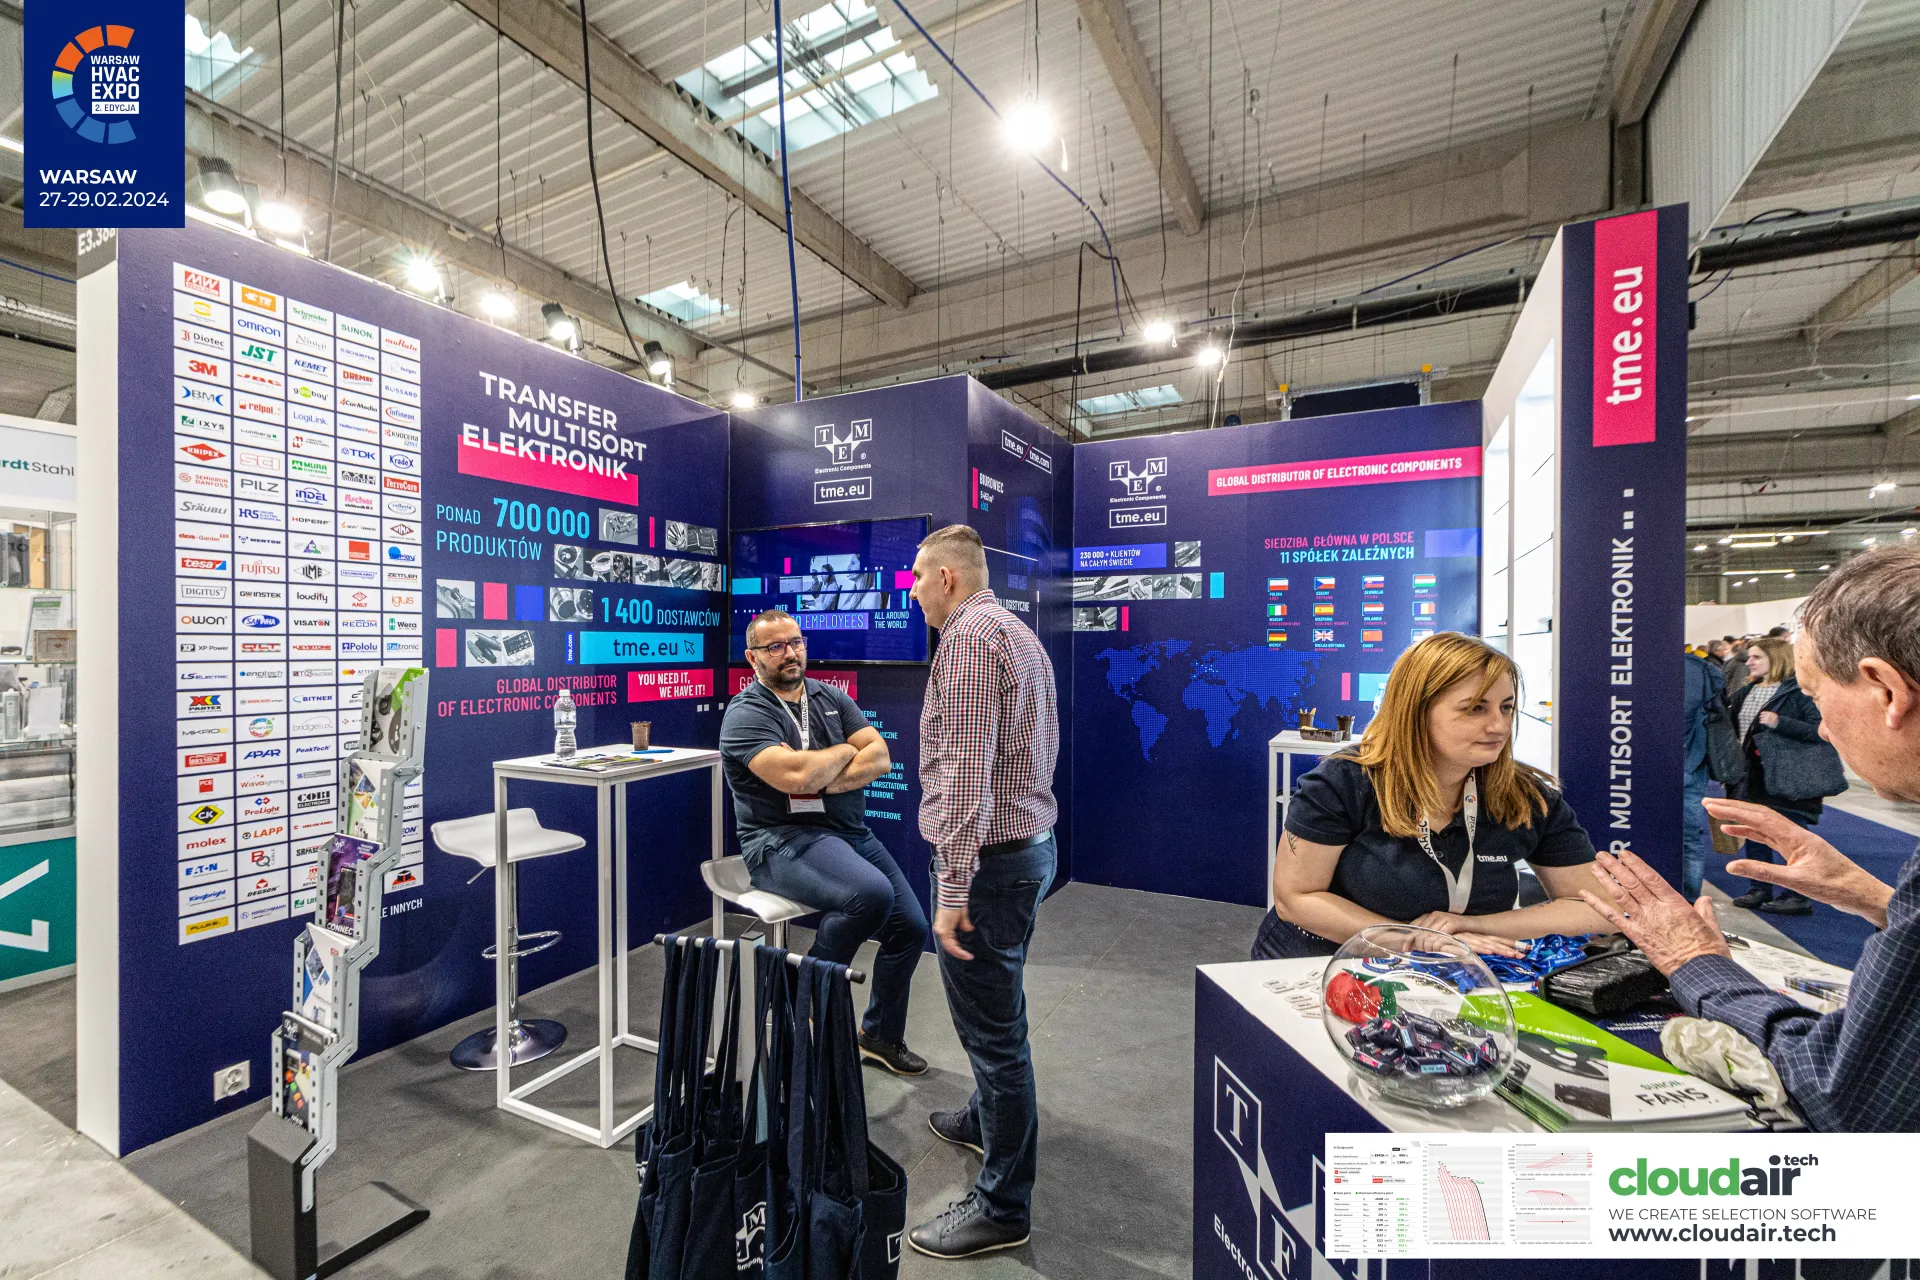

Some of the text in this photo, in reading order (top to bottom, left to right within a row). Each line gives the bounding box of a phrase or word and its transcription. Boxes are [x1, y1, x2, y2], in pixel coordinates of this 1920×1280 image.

[293, 307, 327, 322] Schneider
[341, 324, 373, 338] SUNON
[1605, 266, 1643, 406] tme.eu
[193, 332, 224, 347] Diotec
[241, 344, 277, 362] JST
[188, 360, 218, 376] 3M
[294, 359, 328, 372] KEMET
[479, 371, 618, 431] TRANSFER
[199, 420, 224, 430] IXYS
[293, 412, 327, 425] LogiLink
[508, 407, 647, 461] MULTISORT
[187, 447, 219, 458] KNIPEX
[349, 448, 376, 460] TDK
[462, 422, 628, 480] ELEKTRONIK
[1004, 436, 1050, 469] tme.eu tme.com
[0, 458, 76, 477] rdtStahl
[304, 461, 328, 470] MURR
[815, 463, 872, 474] Electronic Components
[196, 474, 228, 483] SEMIKRON
[1216, 457, 1462, 488] GLOBAL DISTRIBUTOR OF ELECTRONIC COMPONENTS
[196, 480, 228, 488] DANFOSS
[240, 478, 280, 493] PILZ
[386, 478, 418, 492] FerroCore
[980, 472, 1004, 494] BIUROWIEC
[820, 484, 865, 498] tme.eu
[238, 508, 259, 519] HRS
[436, 497, 590, 539] PONAD 700 000
[1116, 511, 1160, 524] tme.eu
[436, 530, 542, 560] PRODUKTÓW
[1264, 531, 1414, 550] SIEDZIBA GŁÓWNA W POLSCE
[1080, 548, 1141, 560] 230 000 KLIENTÓW
[1280, 546, 1415, 564] 11 SPÓŁEK ZALEŻNYCH
[184, 558, 214, 568] tesa
[241, 561, 280, 576] FUJITSU
[1080, 556, 1133, 568] NA CAŁYM ŚWIECIE
[186, 588, 220, 596] DIGITUS
[296, 592, 328, 604] loudity
[392, 596, 414, 607] igus
[774, 604, 788, 612] OVER
[615, 598, 653, 625] 400
[656, 608, 720, 627] DOSTAWCÓW
[874, 611, 910, 620] ALL AROUND
[398, 622, 418, 630] Wera
[805, 614, 864, 628] EMPLOYEES
[874, 620, 908, 629] THE WORLD
[351, 642, 378, 650] Pololu
[614, 638, 678, 656] tme.eu
[496, 674, 617, 694] GLOBAL DISTRIBUTOR
[638, 672, 691, 686] YOU NEED IT,
[1610, 537, 1634, 829] MULTISORT ELEKTRONIK
[660, 685, 706, 698] WE HAVE IT!
[438, 701, 454, 717] OF
[460, 695, 541, 716] ELECTRONIC
[244, 749, 281, 760] APAR
[296, 746, 330, 754] PeakTech
[871, 782, 908, 791] WARSZTATOWE
[298, 790, 330, 802] COBI
[871, 790, 894, 800] BIUROWE
[298, 800, 330, 808] ELECTRONIC
[244, 806, 280, 816] ProLight
[253, 826, 283, 838] LAPP
[186, 837, 227, 850] molex
[1477, 854, 1508, 862] tme.eu
[246, 886, 278, 897] DEGSON
[251, 904, 286, 916] HIRSCHMANN
[390, 898, 423, 915] INNYCH
[1536, 1028, 1598, 1045] Accessories
[1635, 1087, 1710, 1110] FANS
[1226, 1084, 1248, 1146] T
